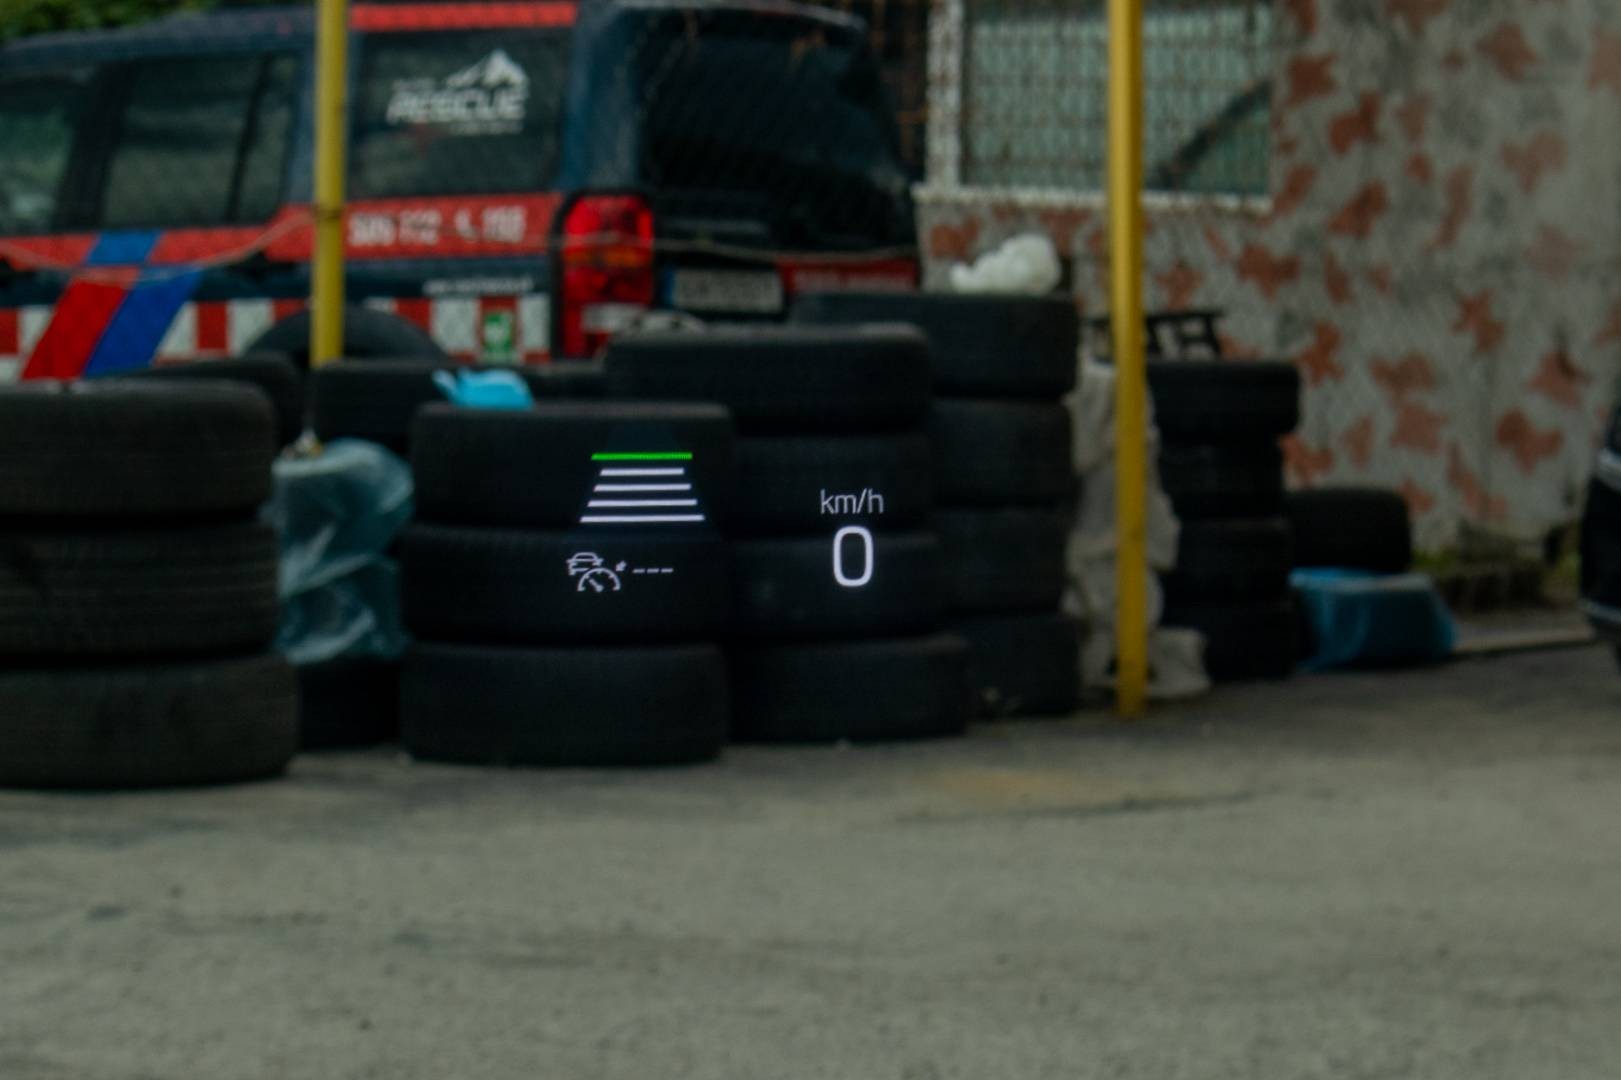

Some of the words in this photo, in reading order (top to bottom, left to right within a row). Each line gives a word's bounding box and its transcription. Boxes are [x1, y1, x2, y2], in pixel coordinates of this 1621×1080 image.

[385, 86, 527, 124] RESCUE
[820, 488, 884, 515] km/h
[832, 525, 874, 588] 0
